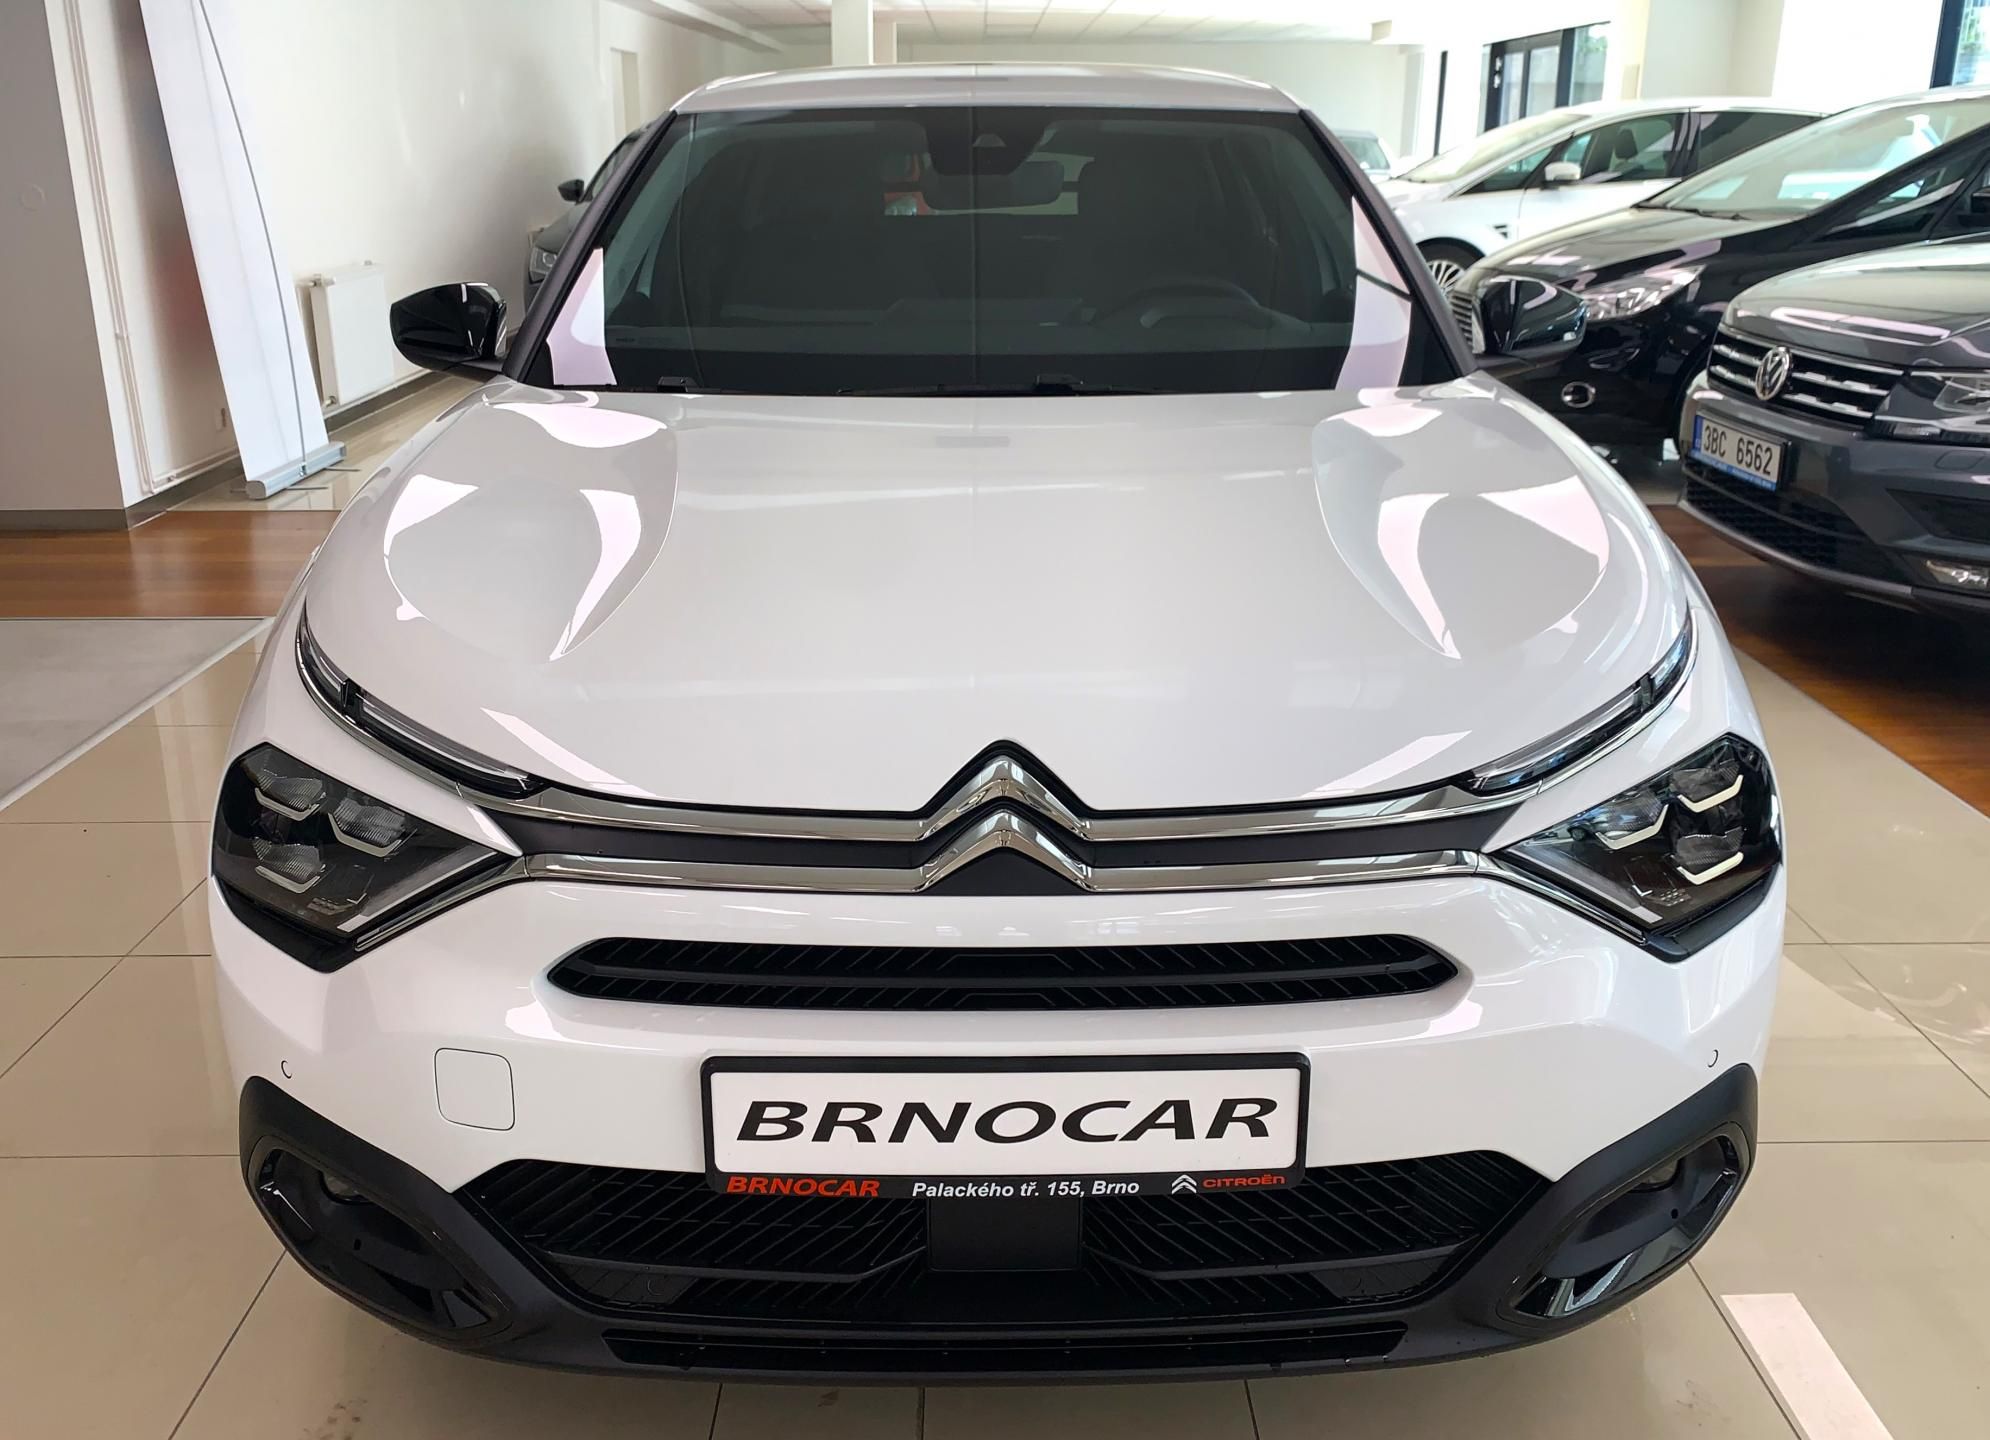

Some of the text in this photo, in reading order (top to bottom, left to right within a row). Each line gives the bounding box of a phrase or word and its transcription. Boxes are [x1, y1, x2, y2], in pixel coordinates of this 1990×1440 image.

[1704, 426, 1727, 458] 3BC
[1736, 437, 1773, 476] 6562
[736, 1097, 1278, 1144] BRNOCAR
[726, 1176, 881, 1197] BRNOCAR
[912, 1180, 1140, 1197] Palackého tř. 155, Brno
